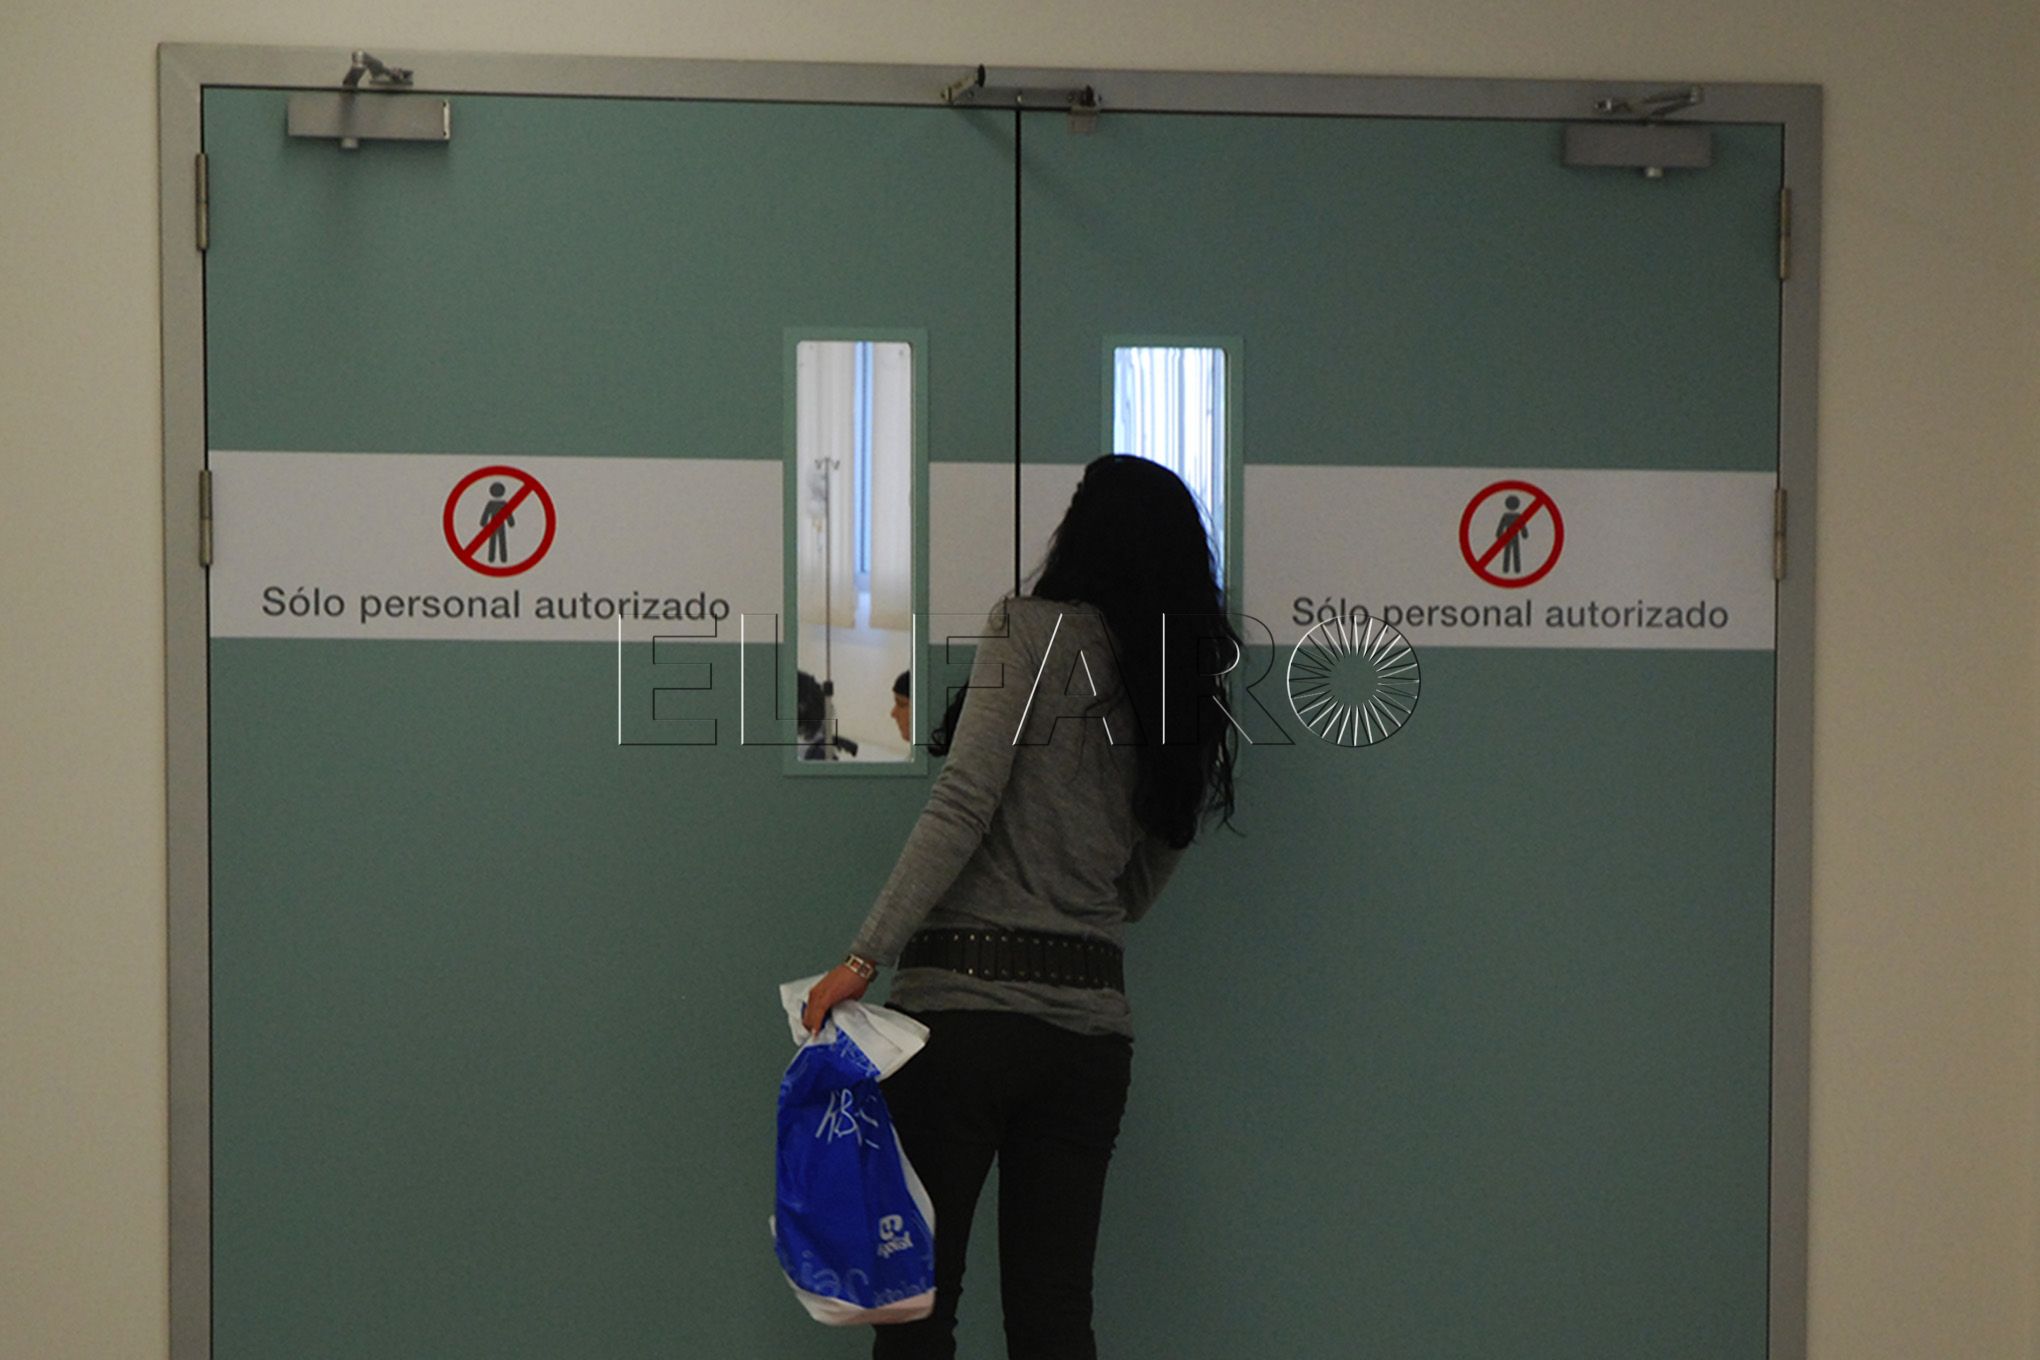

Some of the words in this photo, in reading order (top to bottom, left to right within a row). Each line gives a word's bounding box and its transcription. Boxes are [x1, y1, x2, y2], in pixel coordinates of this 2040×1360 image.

[261, 585, 345, 617] Sólo
[360, 590, 519, 624] personal
[534, 590, 730, 620] autorizado
[1291, 596, 1369, 627] Sólo
[1383, 598, 1532, 635] personal
[1545, 599, 1728, 628] autorizado
